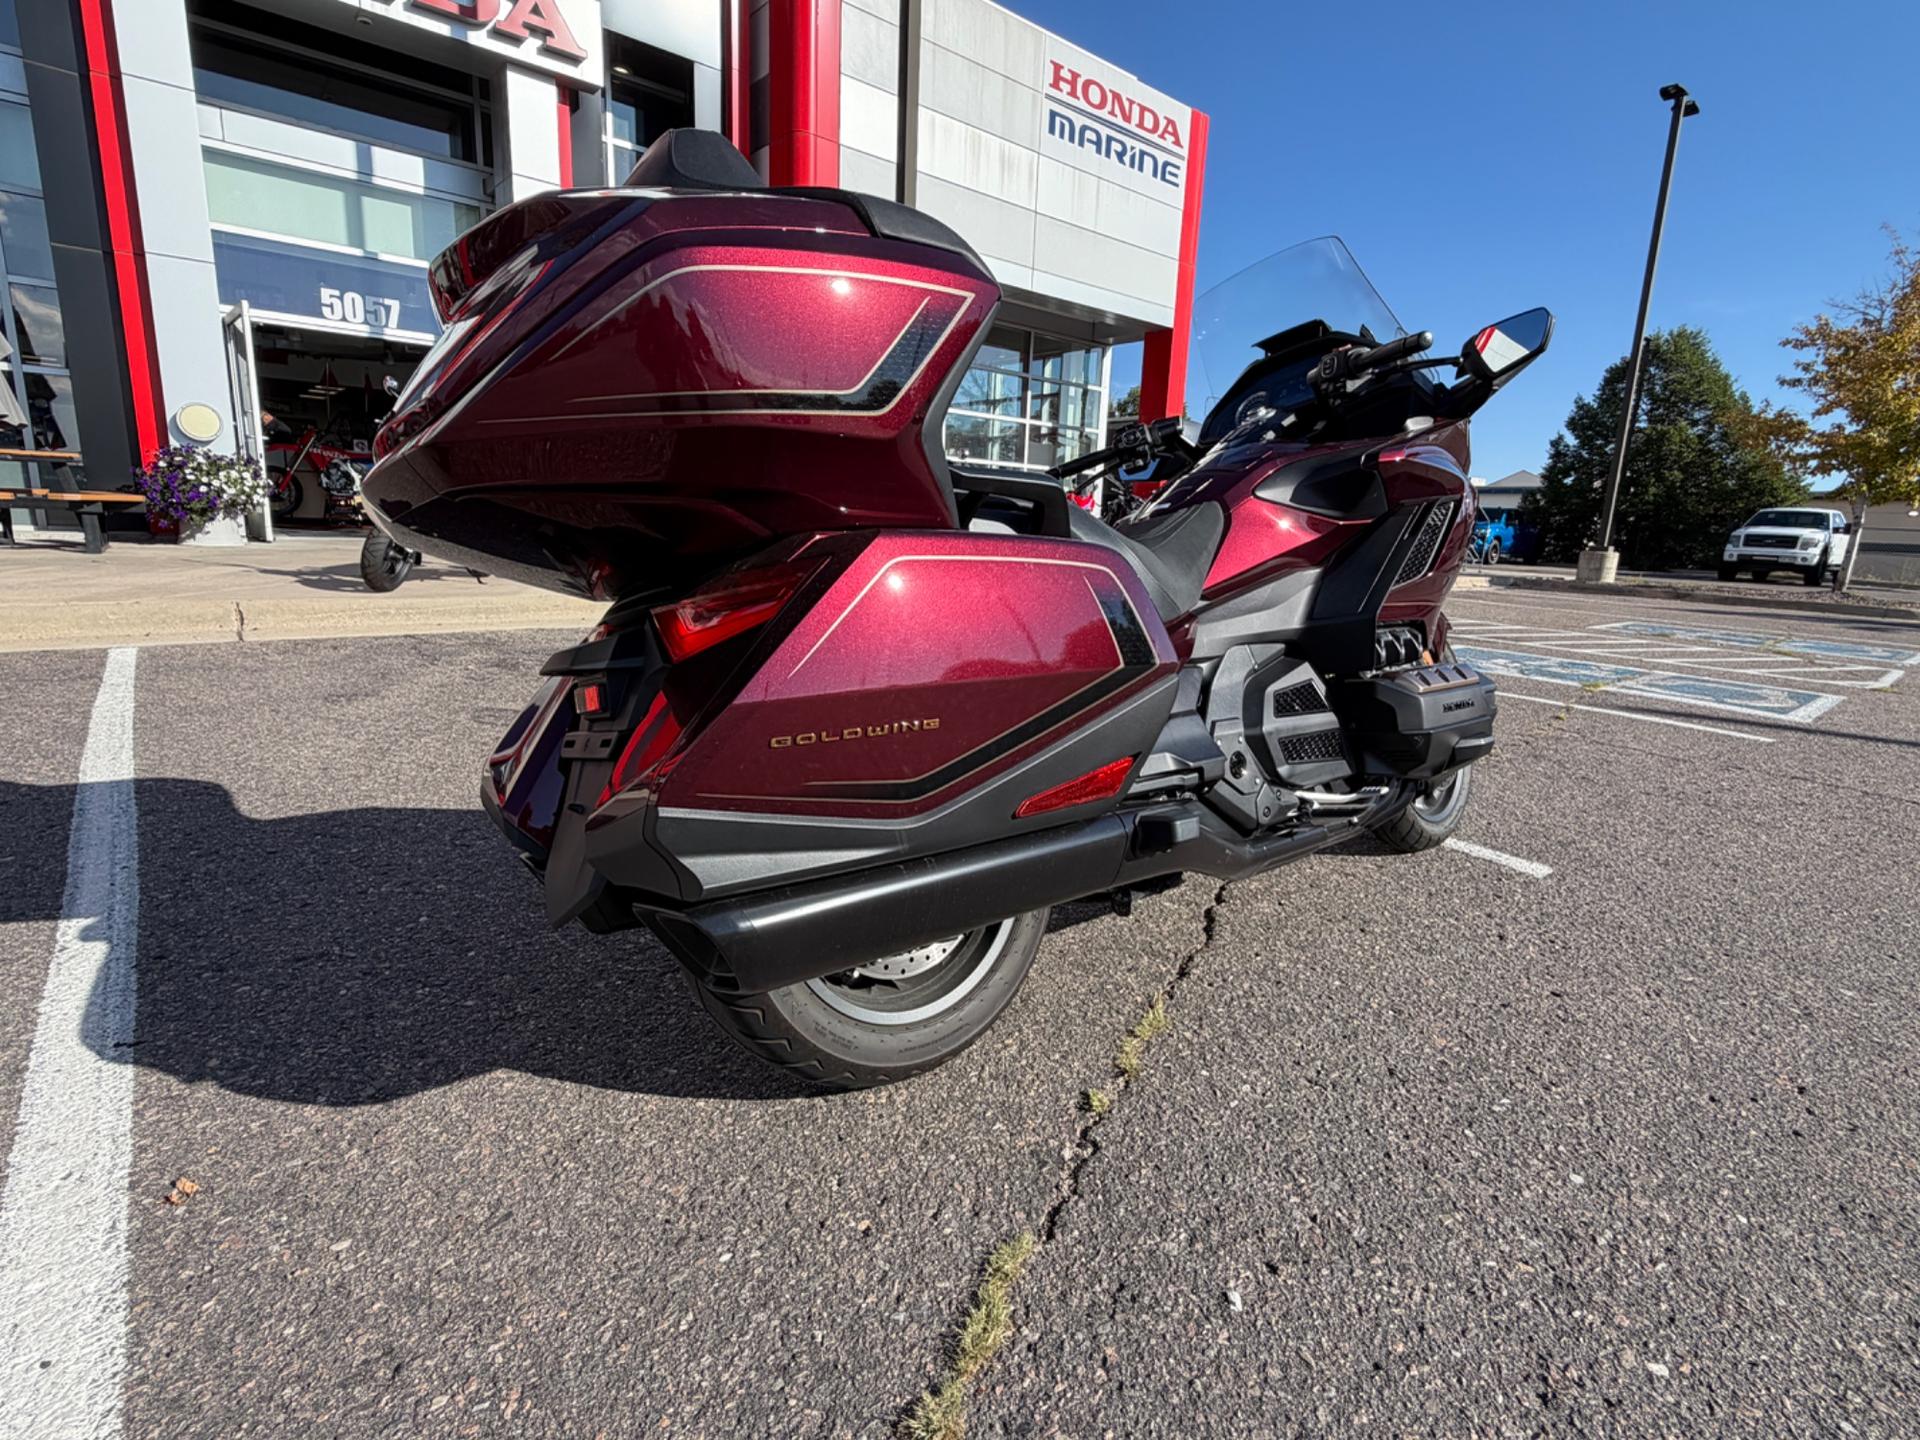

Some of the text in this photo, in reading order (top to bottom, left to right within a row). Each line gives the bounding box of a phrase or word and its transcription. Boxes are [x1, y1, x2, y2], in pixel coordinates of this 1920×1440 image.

[1049, 60, 1184, 149] HONDA
[320, 287, 400, 329] 5057
[769, 718, 941, 749] GOLDWING
